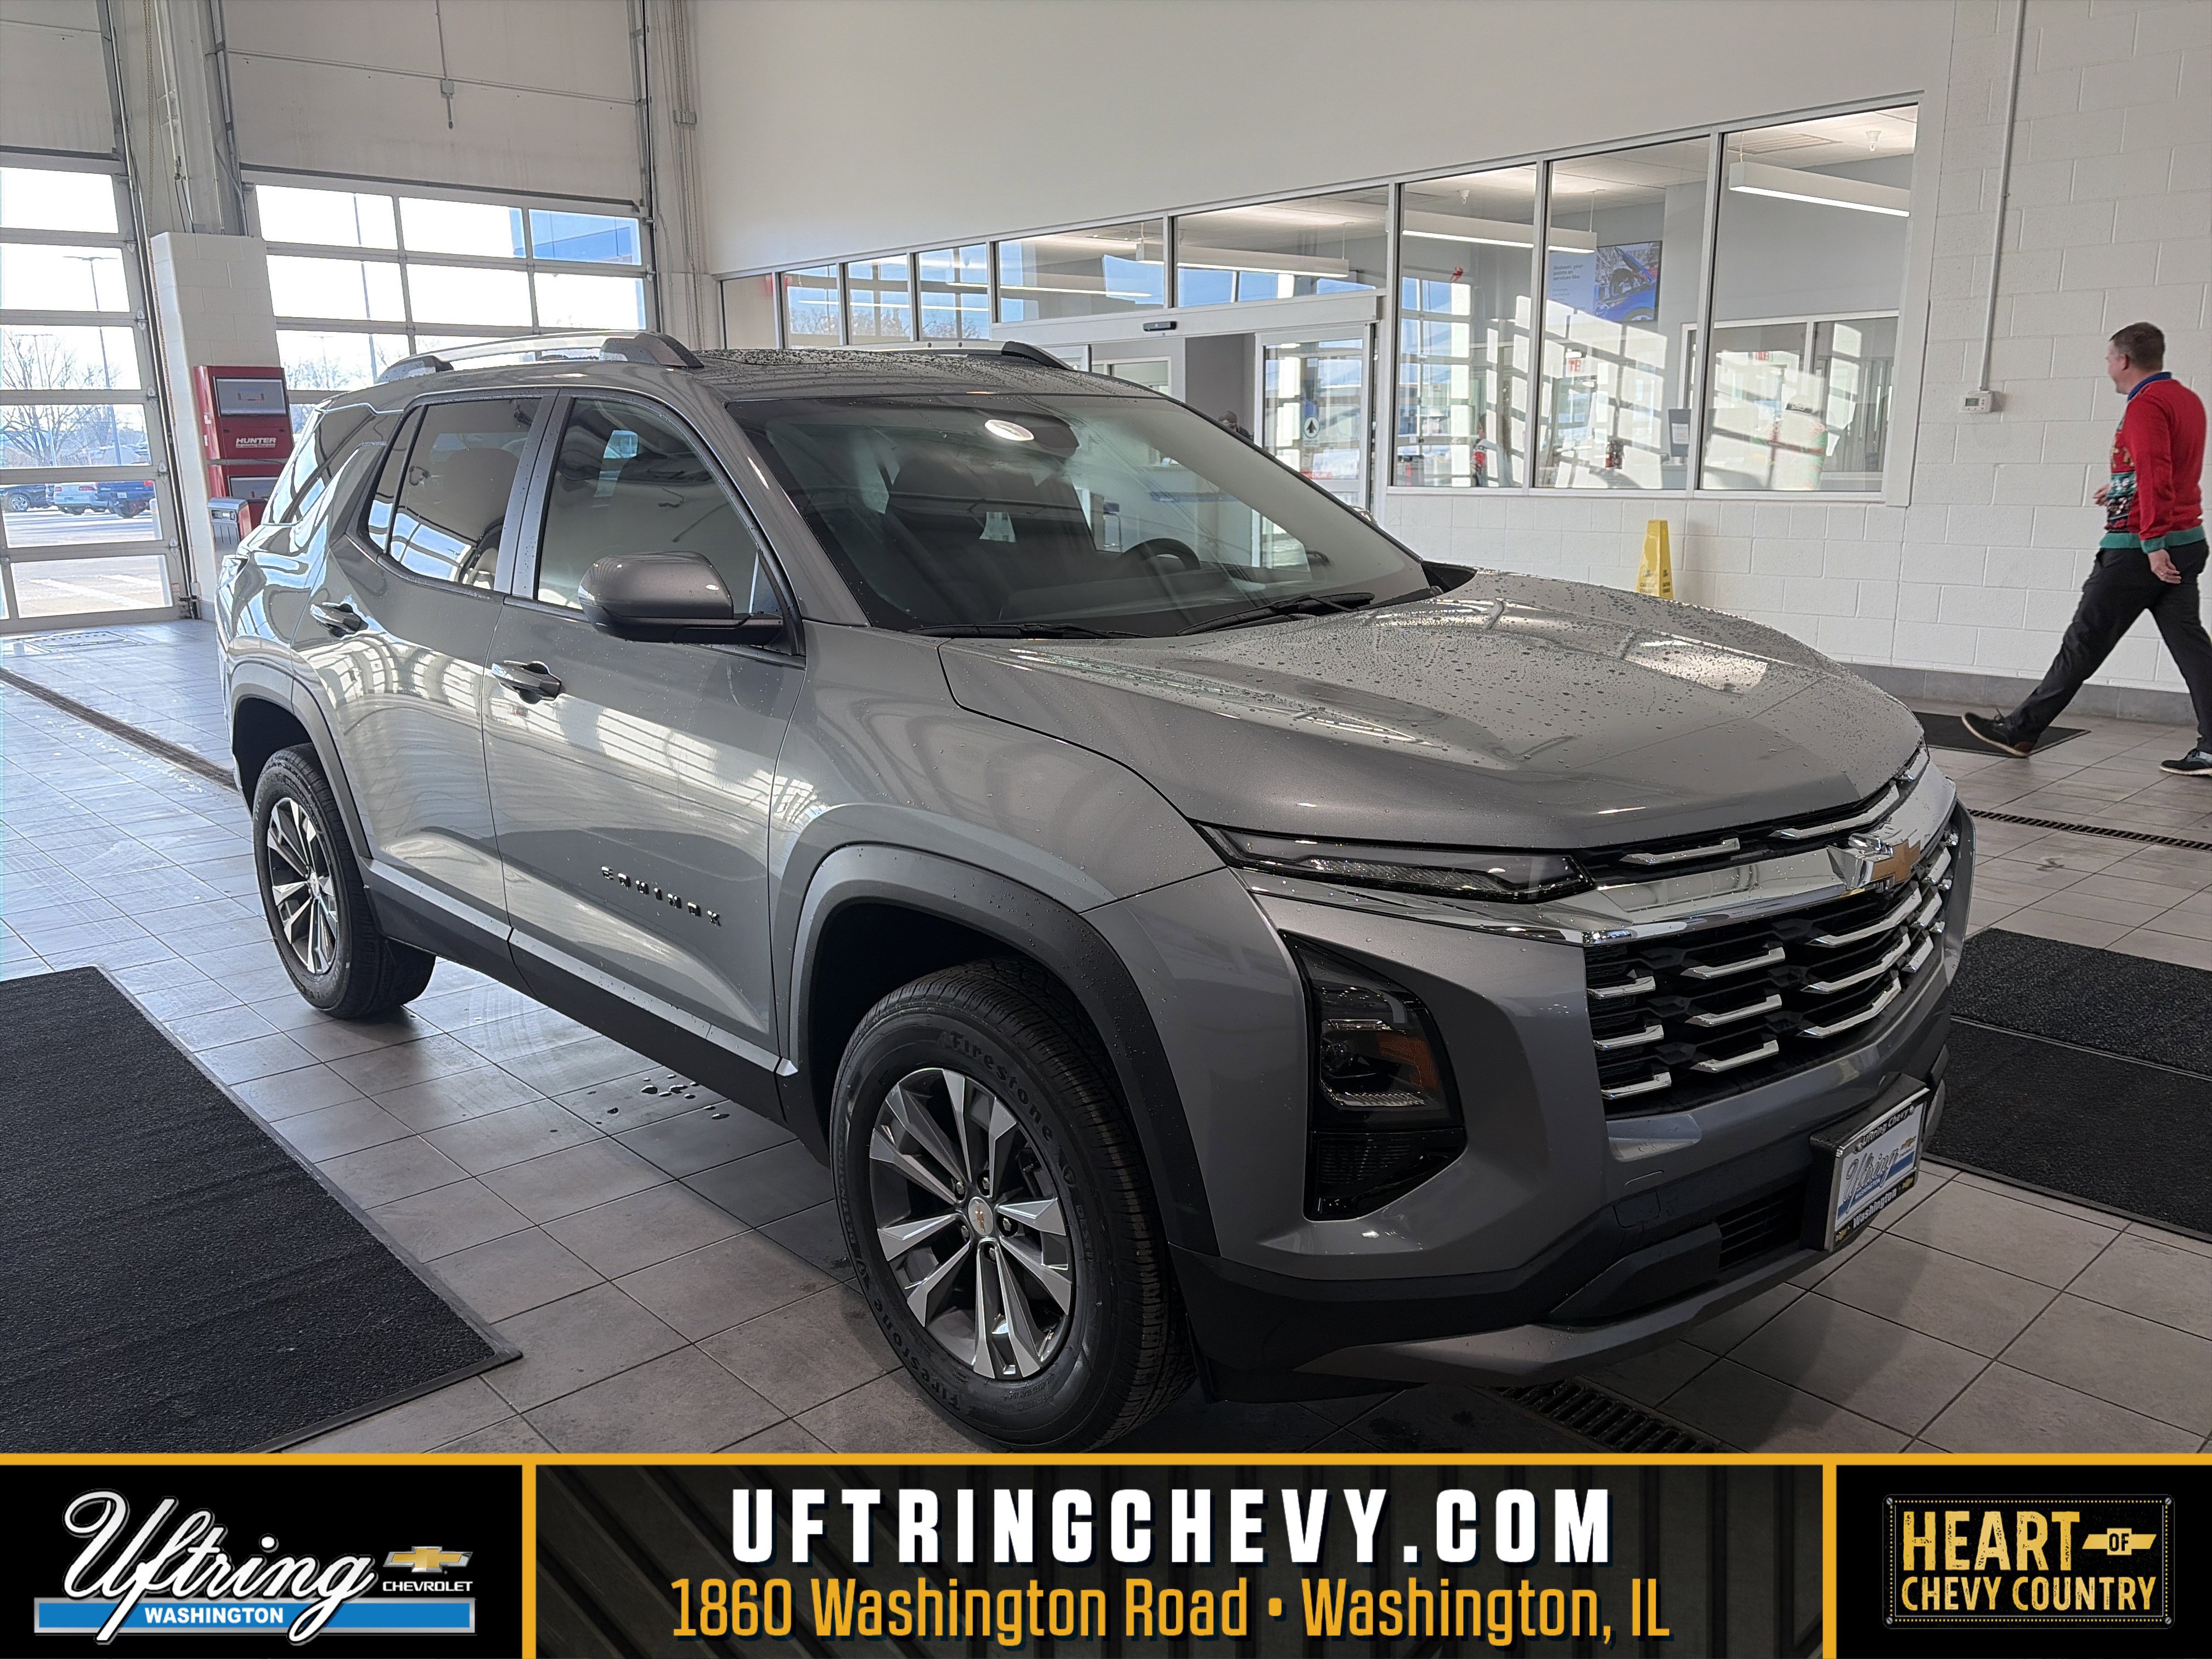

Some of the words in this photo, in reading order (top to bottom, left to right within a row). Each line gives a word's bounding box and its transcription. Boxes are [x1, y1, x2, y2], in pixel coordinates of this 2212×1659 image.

[602, 866, 722, 927] EQUINOX
[950, 1030, 1053, 1142] Firestone
[1888, 1108, 1910, 1128] Chevy
[1843, 1148, 1899, 1214] Uftring
[1853, 1188, 1897, 1229] Washington
[873, 1298, 962, 1412] Firestone
